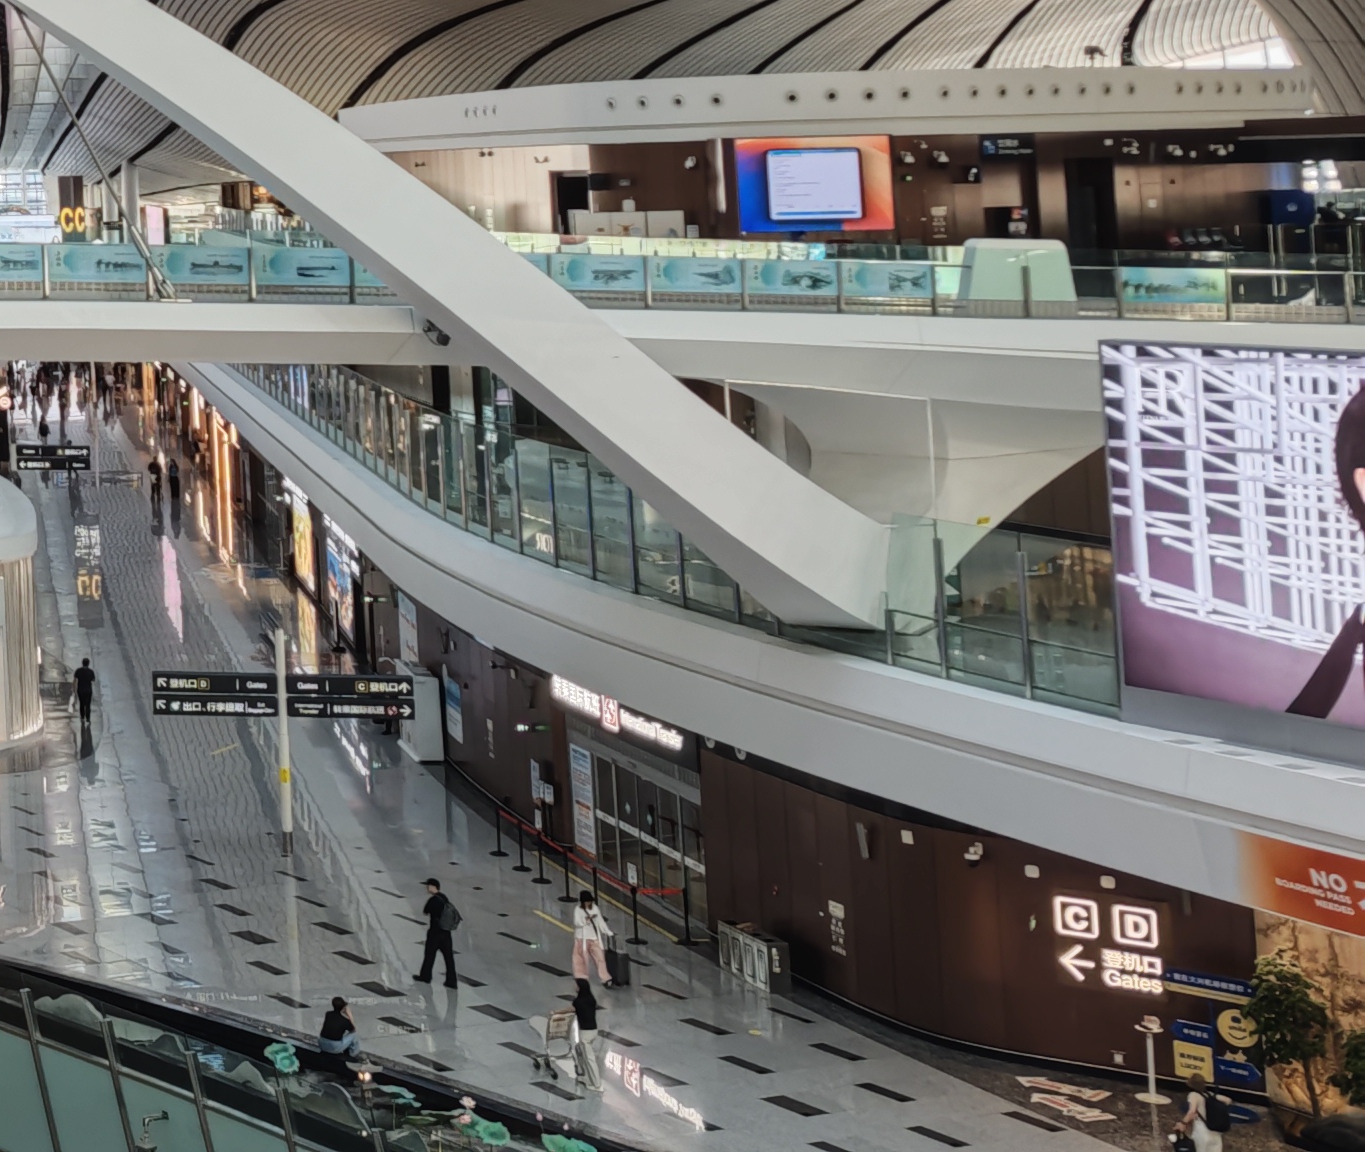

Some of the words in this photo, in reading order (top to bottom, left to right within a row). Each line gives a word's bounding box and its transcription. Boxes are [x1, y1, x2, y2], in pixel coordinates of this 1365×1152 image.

[246, 680, 268, 689] Gates
[296, 681, 319, 690] Gates
[1309, 867, 1348, 894] NO
[1326, 890, 1353, 905] PASS
[1064, 905, 1089, 931] C
[1123, 913, 1149, 939] D
[1100, 948, 1163, 976] 登机口
[1101, 969, 1164, 995] Gates
